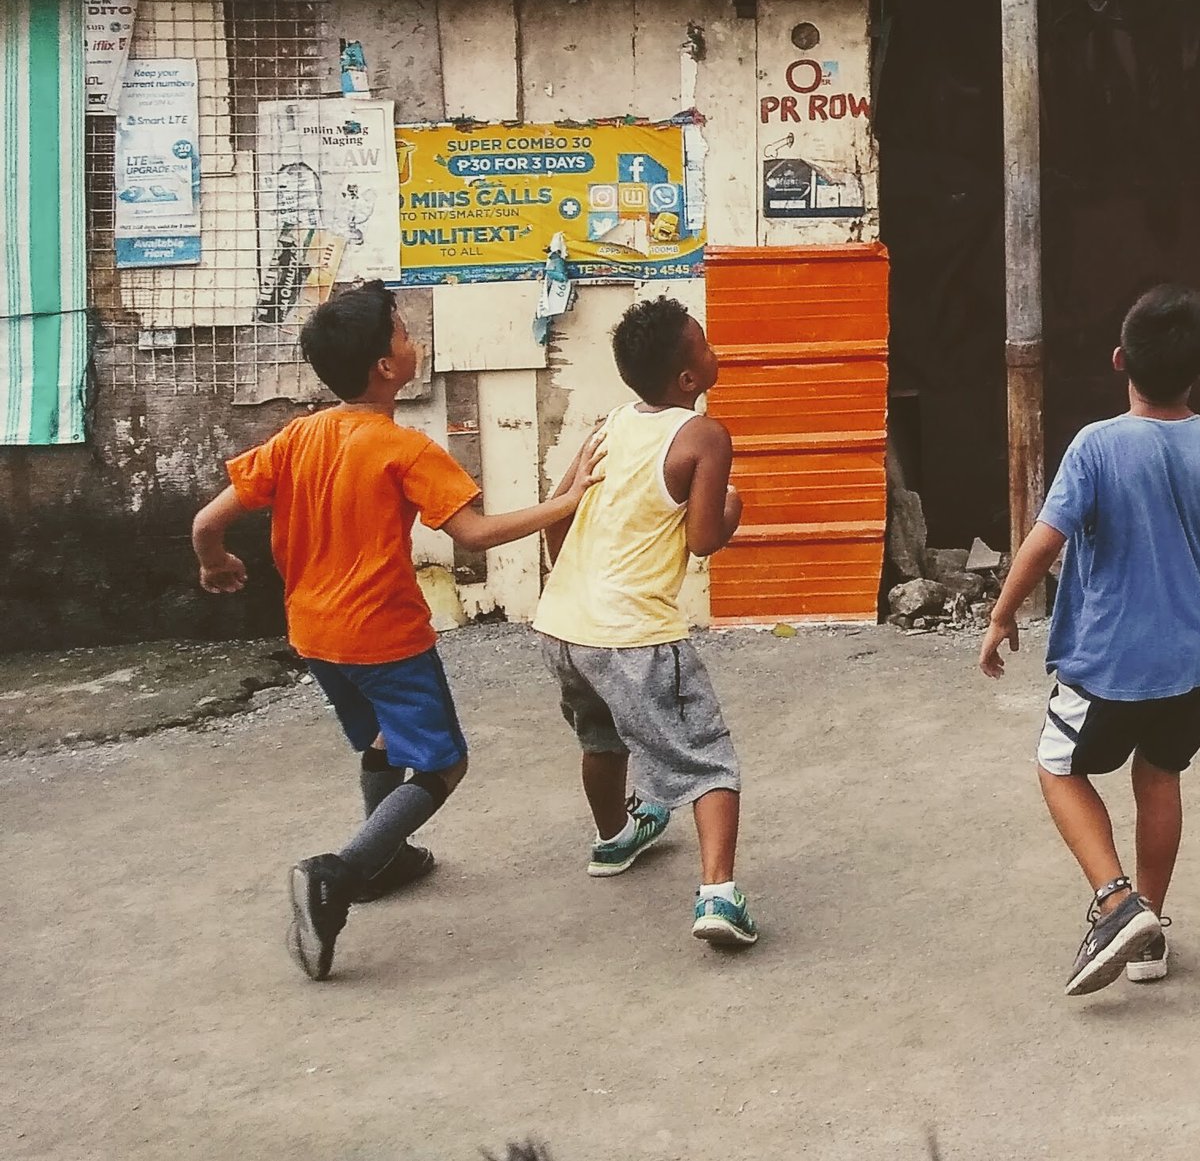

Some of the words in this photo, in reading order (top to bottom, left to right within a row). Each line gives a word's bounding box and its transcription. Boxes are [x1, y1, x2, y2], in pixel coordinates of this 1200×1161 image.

[88, 6, 132, 15] DITO
[92, 40, 116, 51] iflix
[133, 70, 156, 78] Keep
[158, 70, 179, 78] your
[760, 96, 801, 123] PR
[809, 93, 871, 119] ROW
[137, 116, 165, 125] Smart
[168, 115, 188, 125] LTE
[322, 136, 363, 147] Maging
[447, 139, 502, 152] SUPER
[507, 137, 568, 150] COMBO
[572, 137, 592, 149] 30
[127, 156, 148, 166] LTE
[494, 157, 529, 170] FOR
[531, 157, 541, 169] 3
[545, 156, 586, 169] DAYS
[126, 166, 169, 175] UPGRADE
[411, 191, 470, 208] MINS
[477, 188, 552, 207] CALLS
[401, 212, 417, 221] TO
[422, 208, 520, 221] TNT/SMART/SUN
[401, 225, 520, 246] UNLITEXT
[440, 248, 456, 256] TO
[461, 246, 483, 256] ALL
[660, 265, 690, 275] 4545
